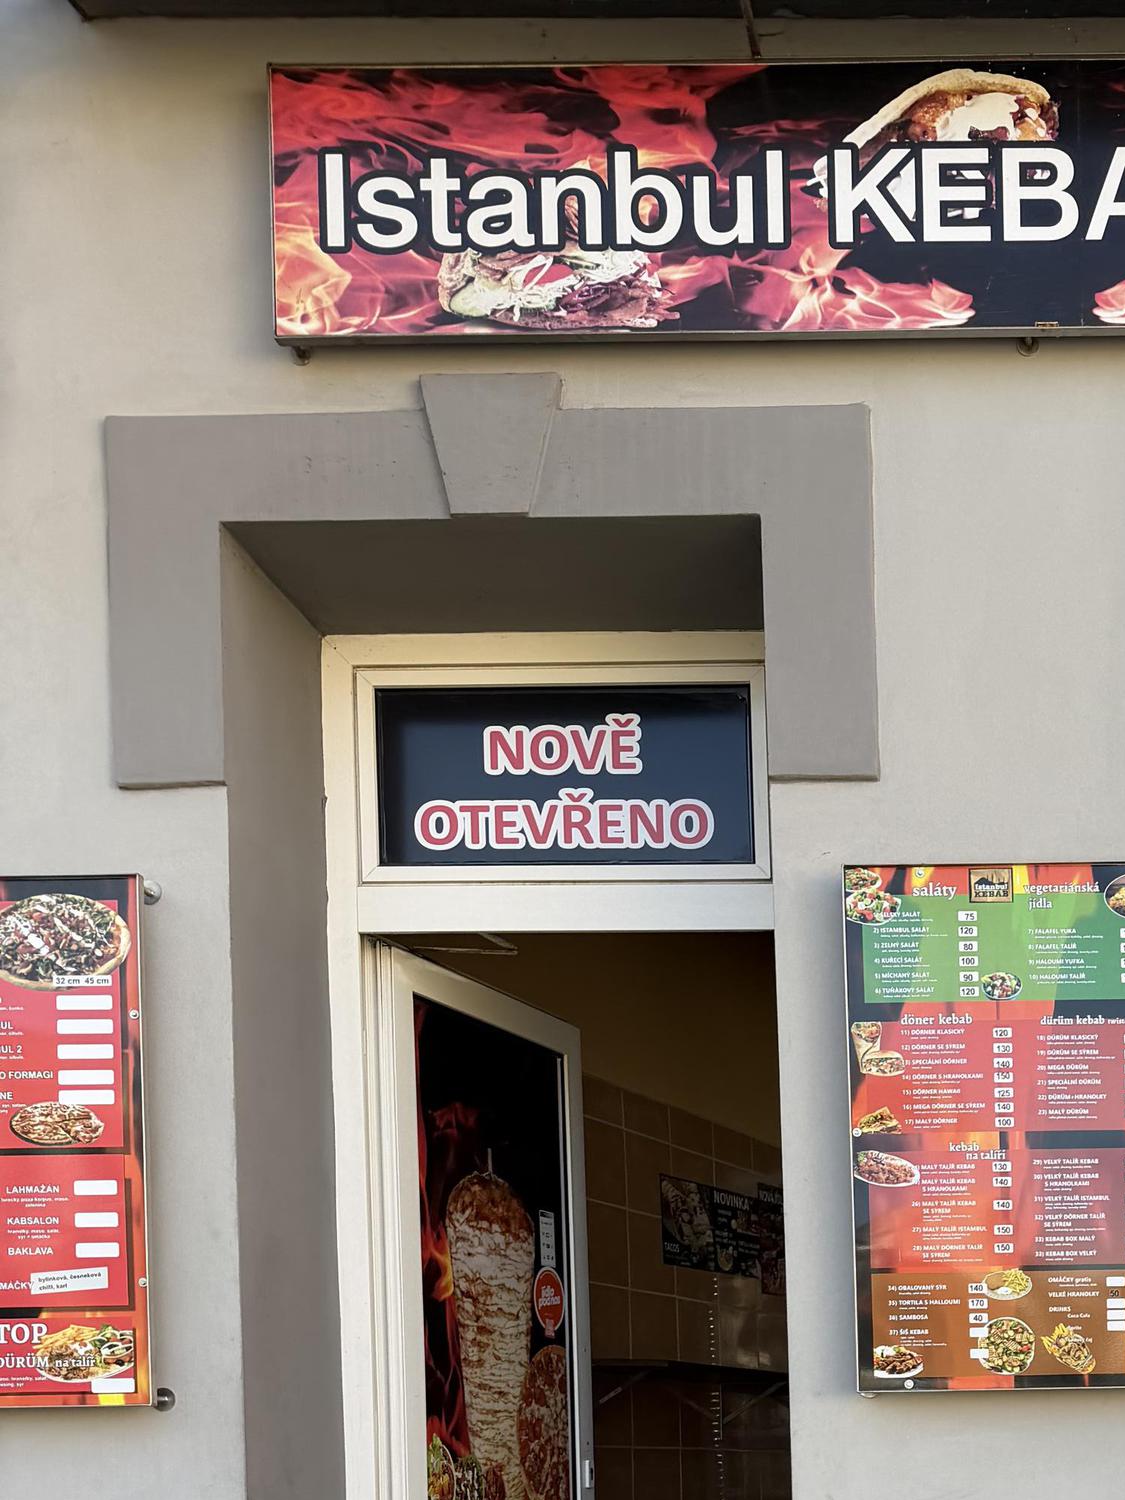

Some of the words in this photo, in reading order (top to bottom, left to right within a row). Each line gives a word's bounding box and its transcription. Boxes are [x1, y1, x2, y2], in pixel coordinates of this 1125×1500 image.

[324, 149, 785, 247] Istanbul
[486, 715, 639, 773] NOVĚ
[417, 790, 711, 847] OTEVŘENO
[913, 882, 957, 900] saláty
[1024, 882, 1099, 896] vegetariánská
[1029, 898, 1052, 910] jídla
[960, 927, 973, 935] 120
[901, 1014, 935, 1025] döner
[938, 1014, 972, 1025] kebab
[1040, 1015, 1073, 1025] dürüm
[1076, 1015, 1105, 1025] kebab
[17, 1045, 22, 1053] 2
[9, 1071, 54, 1079] FORMAGI
[949, 1142, 980, 1152] kebab
[994, 1163, 1007, 1171] 130
[8, 1247, 53, 1255] BAKLAVA
[0, 1324, 48, 1344] TOP
